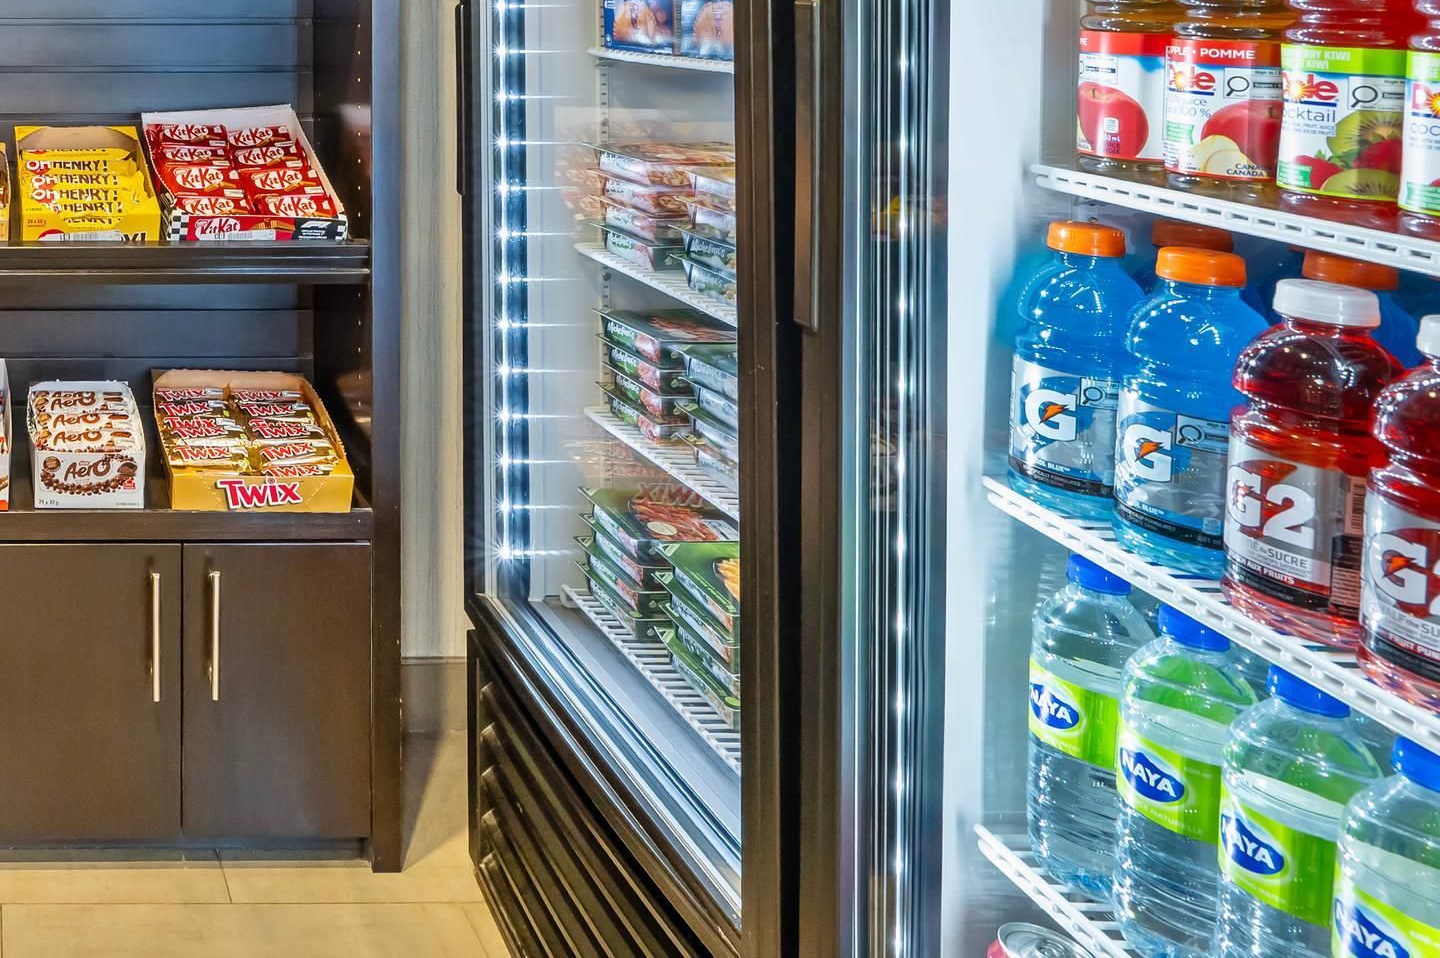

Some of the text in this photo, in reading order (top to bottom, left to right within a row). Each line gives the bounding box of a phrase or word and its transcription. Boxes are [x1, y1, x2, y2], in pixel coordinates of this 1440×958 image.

[1200, 48, 1256, 60] POMME
[181, 168, 221, 188] KitKat
[260, 170, 301, 190] KitKat
[1226, 169, 1265, 177] CANADA
[1025, 389, 1077, 442] G
[1123, 424, 1173, 483] G
[1228, 465, 1315, 550] G2
[1268, 550, 1309, 569] SUCRE
[1263, 567, 1296, 585] FRUITS
[1121, 748, 1177, 799] NAYA
